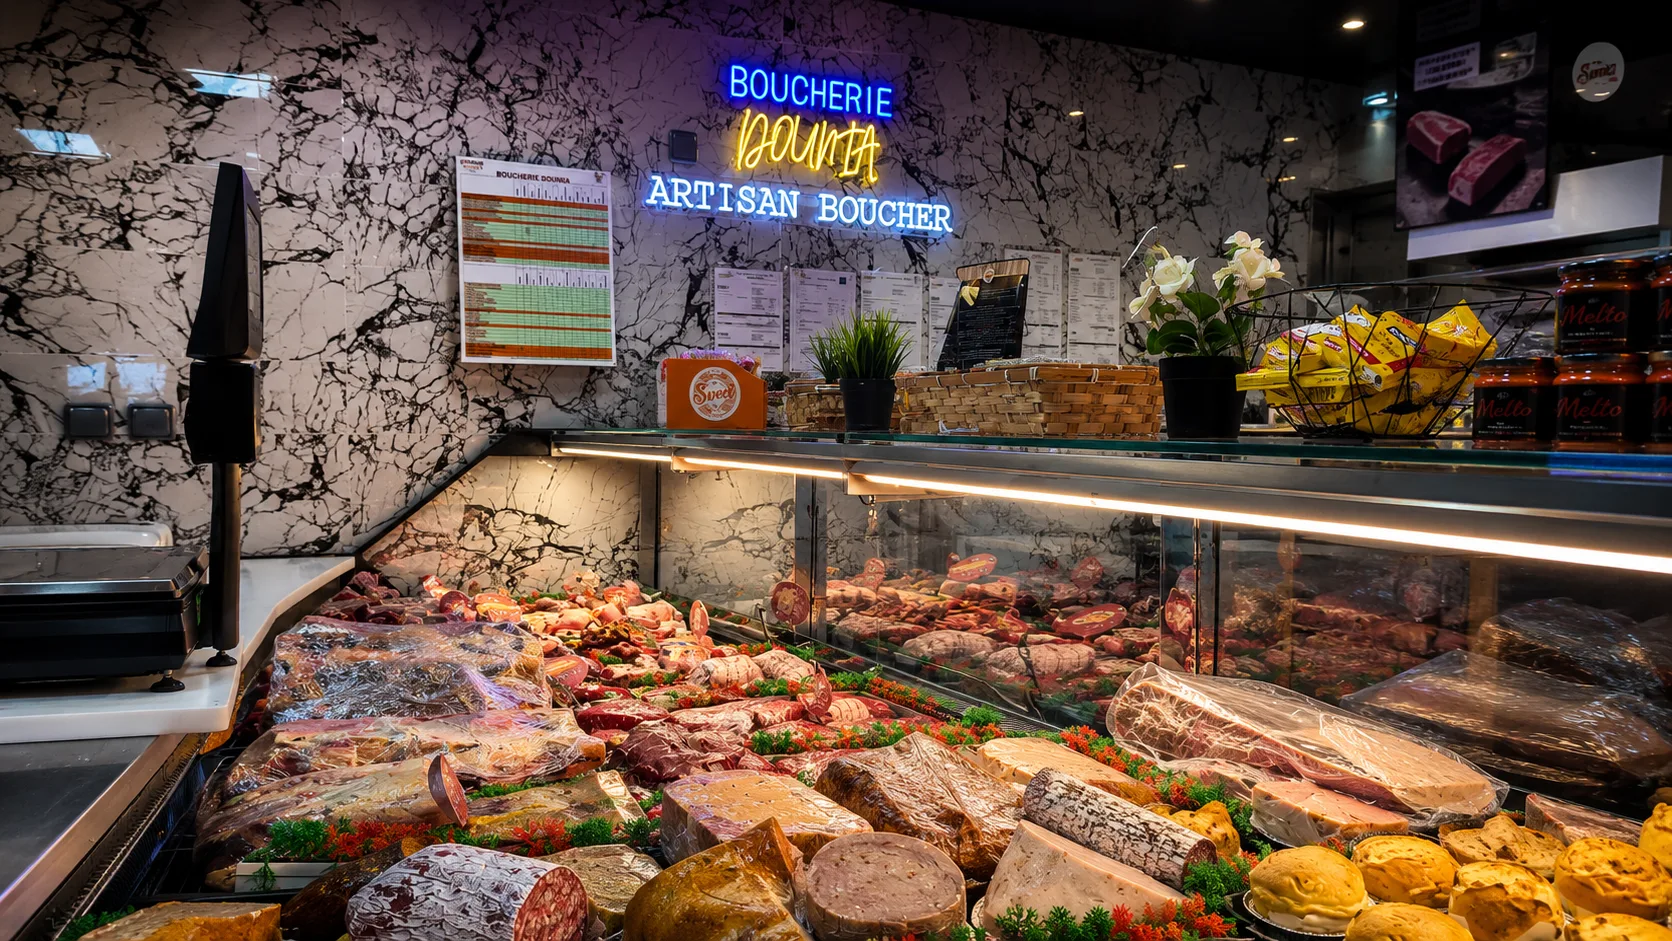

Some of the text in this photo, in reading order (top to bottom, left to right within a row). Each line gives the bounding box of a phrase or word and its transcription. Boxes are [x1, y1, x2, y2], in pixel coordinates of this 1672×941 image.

[730, 64, 893, 118] BOUCHERIE
[735, 108, 881, 183] DOUNIA
[496, 170, 540, 182] BOUCHERIE
[646, 174, 801, 219] ARTISAN
[817, 193, 954, 233] BOUCHER
